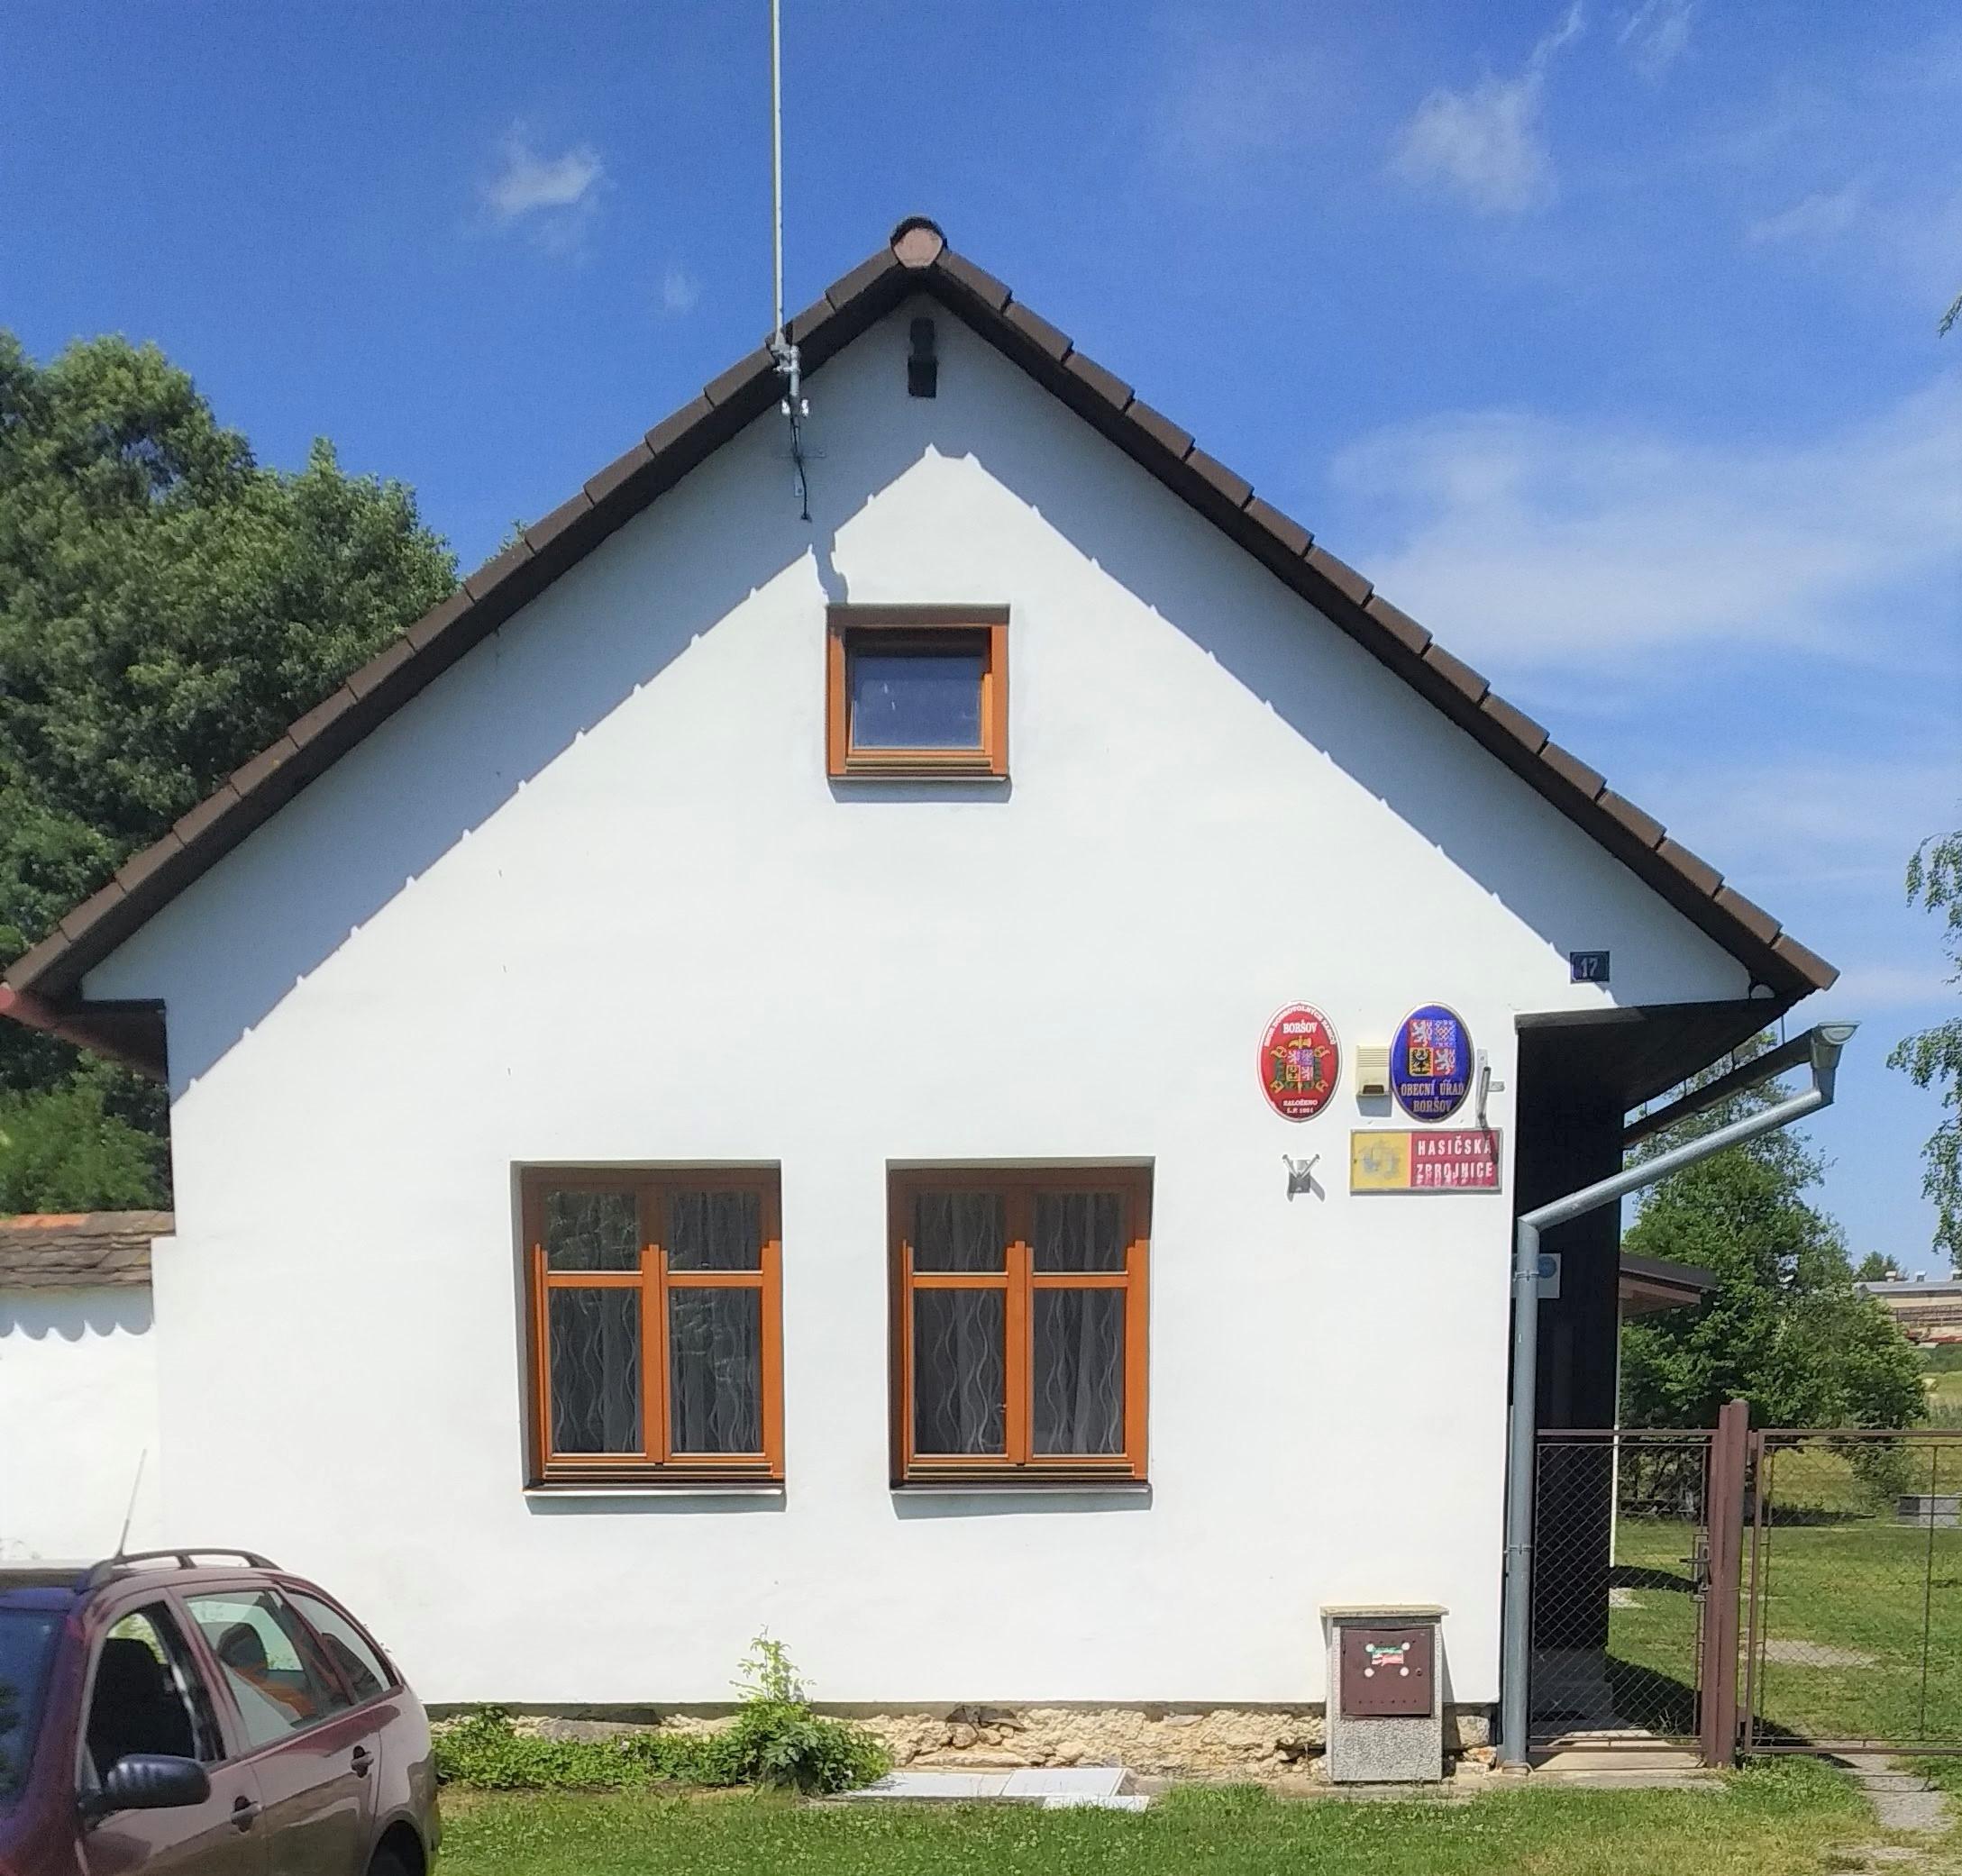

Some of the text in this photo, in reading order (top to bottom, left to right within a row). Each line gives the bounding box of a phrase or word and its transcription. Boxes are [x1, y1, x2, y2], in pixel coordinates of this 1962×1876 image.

[1581, 958, 1599, 977] 17
[1283, 1018, 1318, 1034] BORŠOV
[1401, 1079, 1465, 1097] OBECNÍ ÚŘAD
[1413, 1097, 1453, 1113] BORŠOV
[1418, 1135, 1492, 1155] HASIČSKÁ
